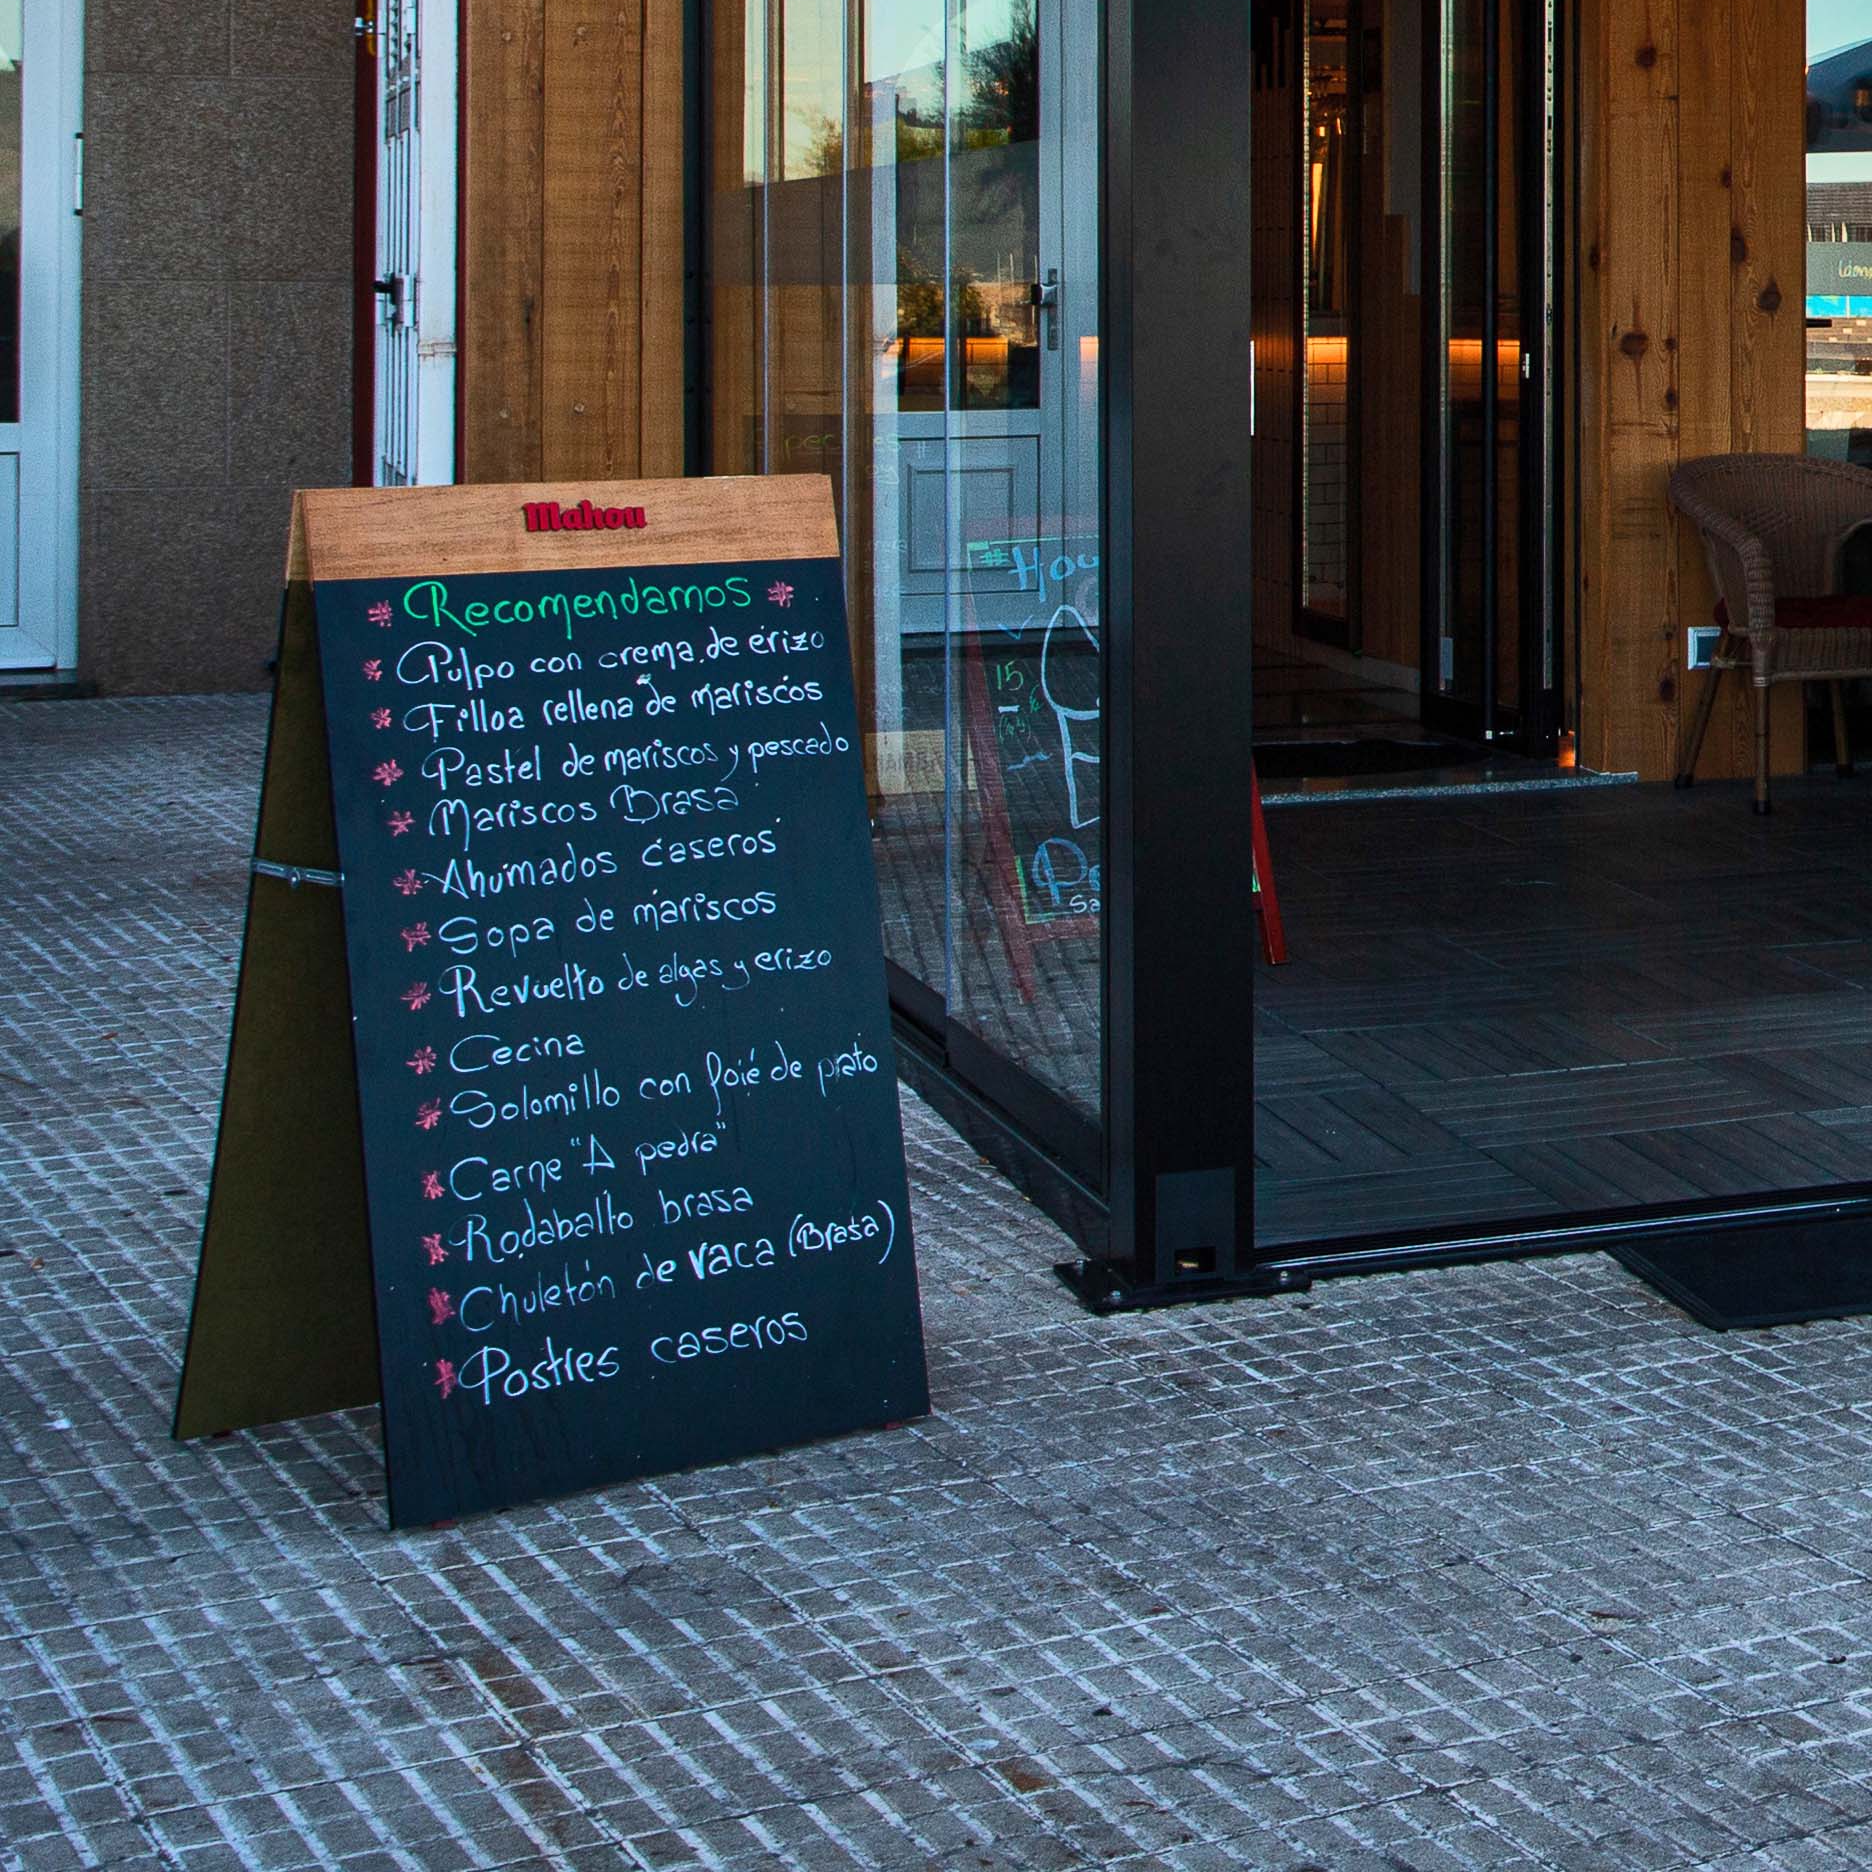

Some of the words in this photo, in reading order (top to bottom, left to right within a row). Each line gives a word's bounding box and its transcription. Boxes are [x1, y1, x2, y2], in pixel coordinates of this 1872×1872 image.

[522, 500, 647, 532] Mahou
[404, 577, 752, 639] Recomendamos
[397, 639, 515, 691] Pulpo
[530, 650, 582, 674] con
[599, 640, 694, 672] crema
[705, 627, 739, 659] de
[749, 625, 825, 654] erizo
[403, 702, 525, 738] Filloa
[543, 690, 633, 727] rellena
[645, 680, 676, 715] de
[691, 678, 823, 712] mariscos
[422, 746, 541, 790] Pastel
[562, 743, 594, 778] de
[604, 742, 720, 772] mariscos
[721, 742, 740, 781] y
[748, 721, 849, 761] pescado
[429, 797, 598, 851] Mariscos
[609, 783, 738, 825] Brasa
[422, 843, 618, 900] Ahumados
[641, 828, 777, 866] caseros
[438, 915, 555, 958] Sopa
[576, 897, 615, 935] de
[633, 889, 777, 923] mariscos
[438, 964, 605, 1017] Revuelto
[618, 952, 649, 988] de
[659, 952, 724, 1007] algas
[721, 958, 752, 990] y
[755, 947, 832, 970] erizo
[449, 1031, 585, 1074] Cecina
[449, 1069, 621, 1129] Solomillo
[639, 1068, 692, 1100] con
[770, 1040, 803, 1081] de
[449, 1155, 562, 1201] Carne
[659, 1183, 753, 1225] brasa
[459, 1261, 616, 1332] Chuletón
[636, 1253, 677, 1290] de
[457, 1336, 620, 1405] Postres
[650, 1310, 808, 1364] caseros
